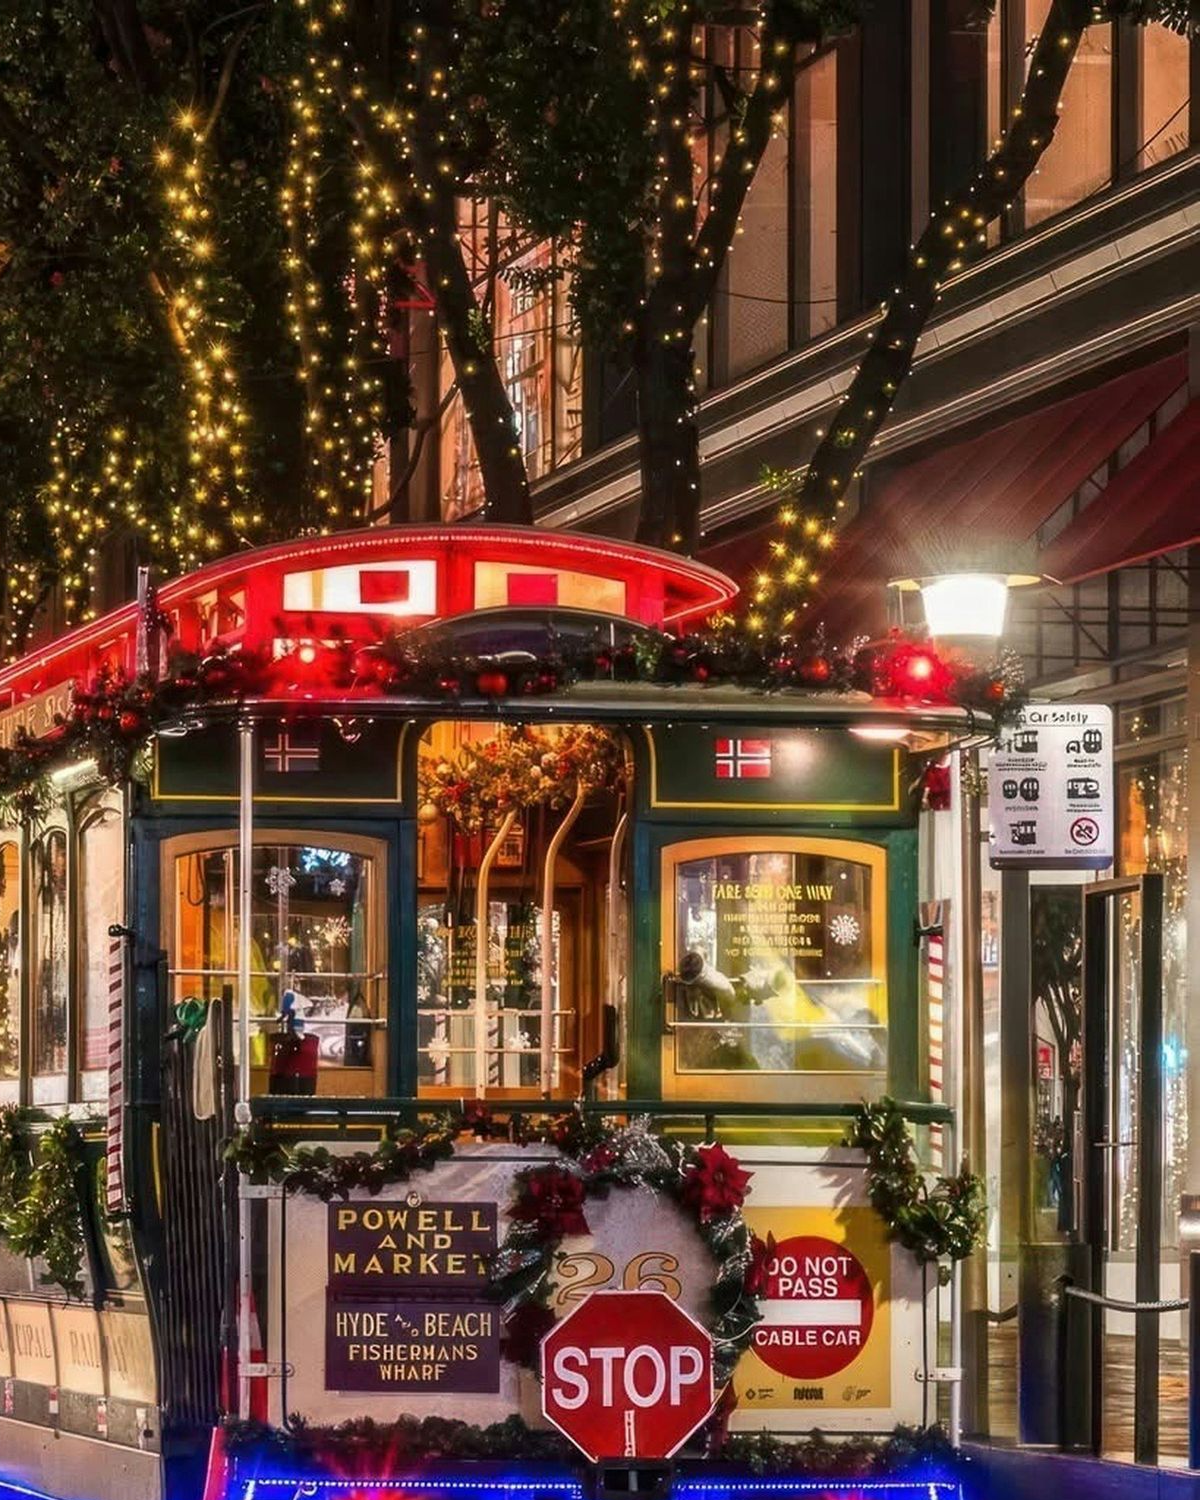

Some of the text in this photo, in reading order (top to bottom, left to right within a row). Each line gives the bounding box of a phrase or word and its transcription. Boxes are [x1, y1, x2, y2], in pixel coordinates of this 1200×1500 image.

[1029, 711, 1049, 723] Car
[337, 1208, 492, 1232] POWELL
[377, 1233, 453, 1250] AND
[333, 1252, 492, 1275] MARKET
[804, 1256, 852, 1277] NOT
[556, 1251, 682, 1306] 26
[778, 1277, 839, 1297] PASS
[335, 1312, 389, 1337] HYDE
[424, 1312, 492, 1337] BEACH
[755, 1330, 861, 1346] CABLE CAR
[348, 1344, 479, 1361] FISHERMANS
[379, 1363, 448, 1381] WHARF
[551, 1343, 705, 1410] STOP
